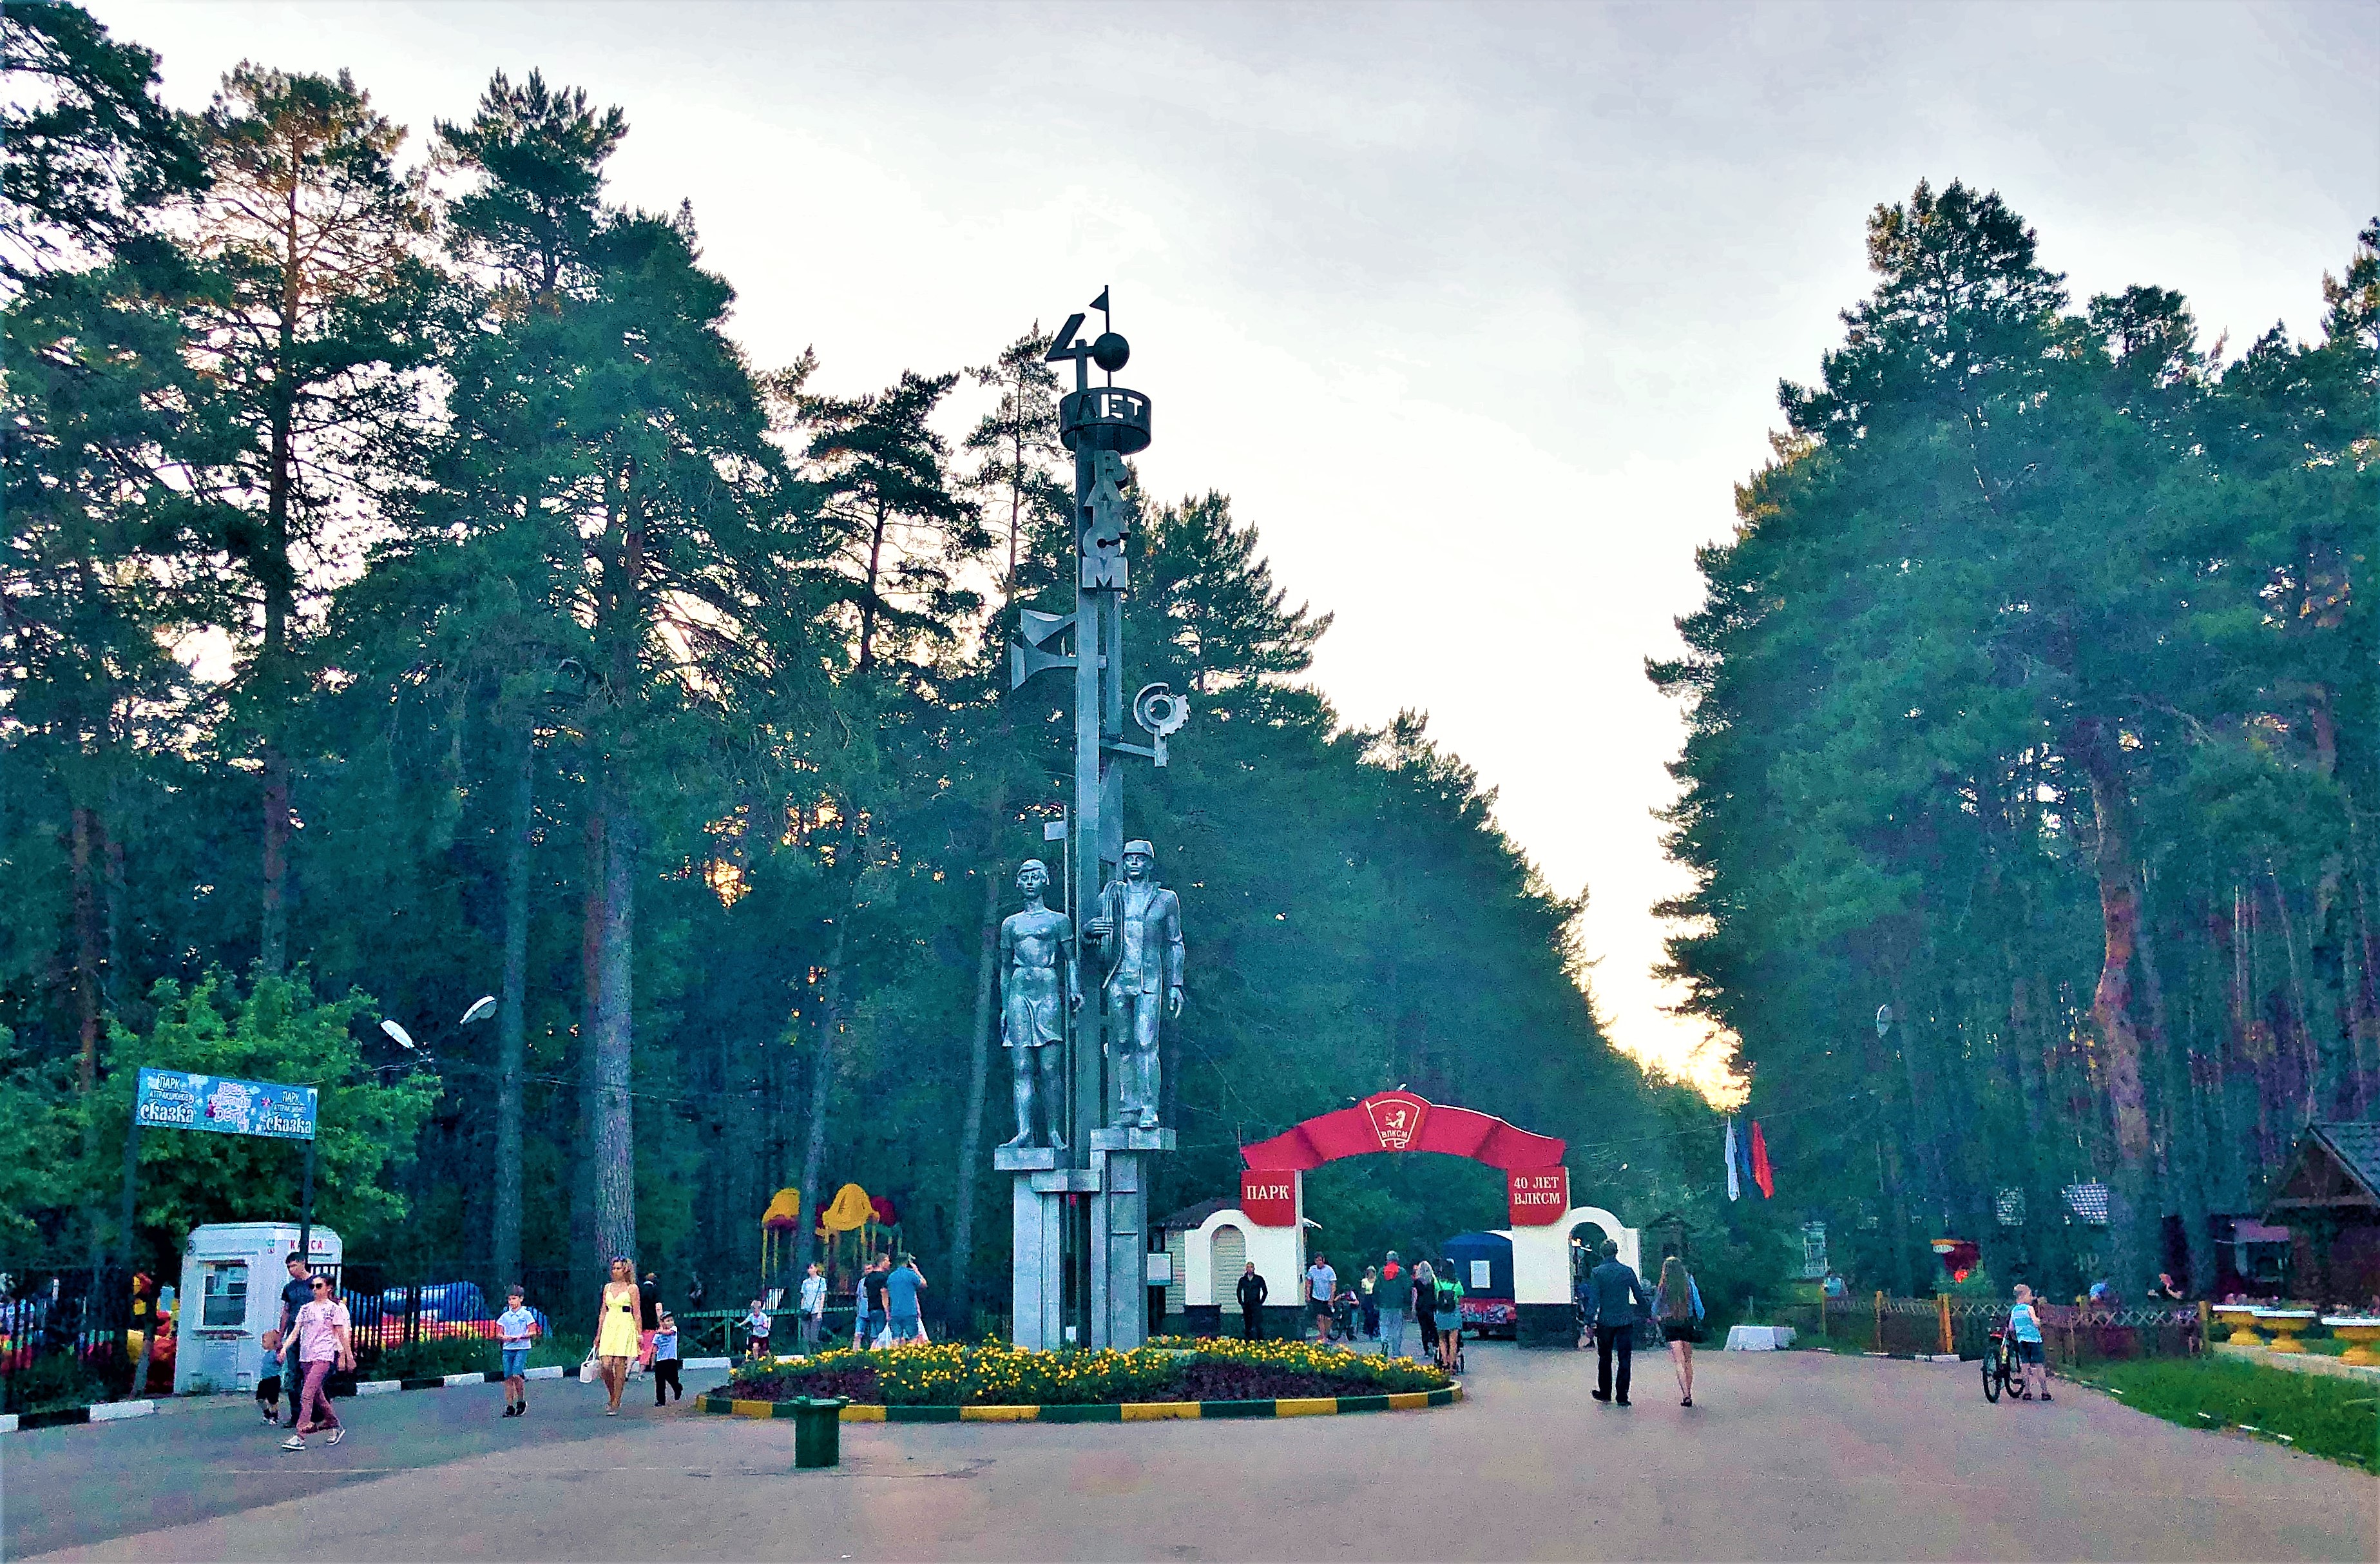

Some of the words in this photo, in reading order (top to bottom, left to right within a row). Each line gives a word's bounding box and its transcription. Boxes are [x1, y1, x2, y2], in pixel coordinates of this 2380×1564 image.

[158, 1074, 180, 1090] ПАРК
[282, 1090, 301, 1104] ПАРК
[1381, 1130, 1408, 1139] ВЛКСМ
[1513, 1177, 1528, 1189] 40
[1532, 1176, 1559, 1189] ЛЕТ
[1246, 1184, 1289, 1200] ПАРК
[1514, 1192, 1560, 1204] ВЛКСМ
[290, 1239, 323, 1250] КАСА
